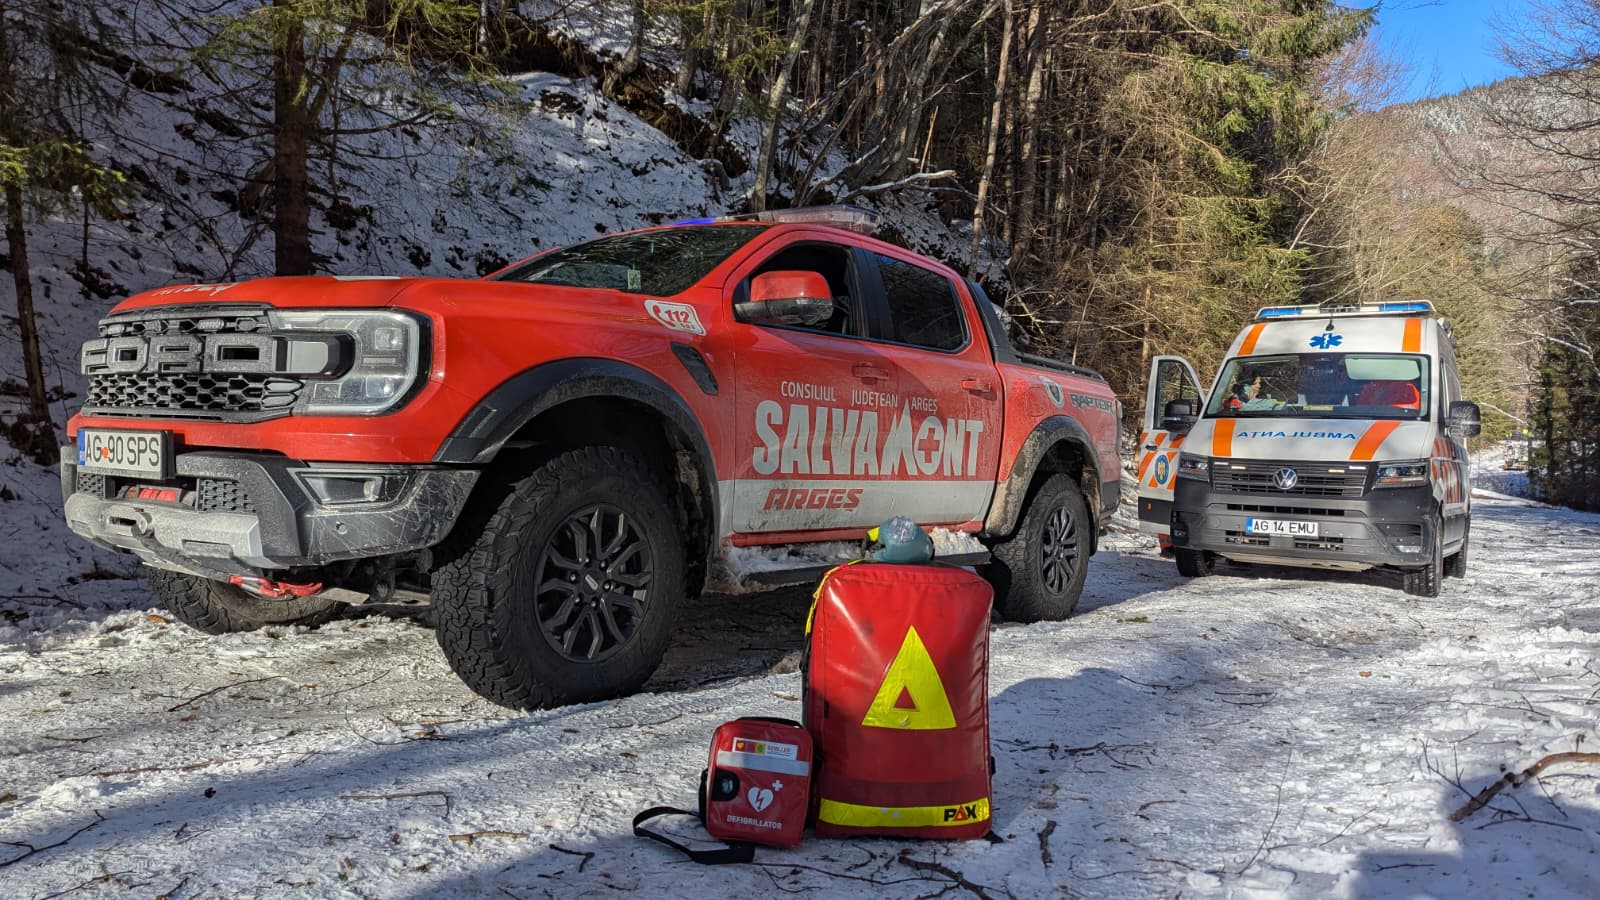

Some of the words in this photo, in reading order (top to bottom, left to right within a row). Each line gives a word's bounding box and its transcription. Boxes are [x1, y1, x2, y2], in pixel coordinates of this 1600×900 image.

[664, 309, 690, 323] 112
[781, 380, 836, 402] CONSILIUL
[1070, 393, 1113, 413] RAPTOR
[752, 398, 984, 477] SALVAMONT
[86, 433, 103, 462] AG
[107, 435, 124, 464] 90
[127, 436, 160, 466] SPS
[1254, 520, 1269, 532] AG
[1274, 521, 1285, 533] 14
[1289, 522, 1315, 534] EMU
[727, 814, 782, 830] DEFIBRILLATOR
[943, 804, 978, 822] PAX
